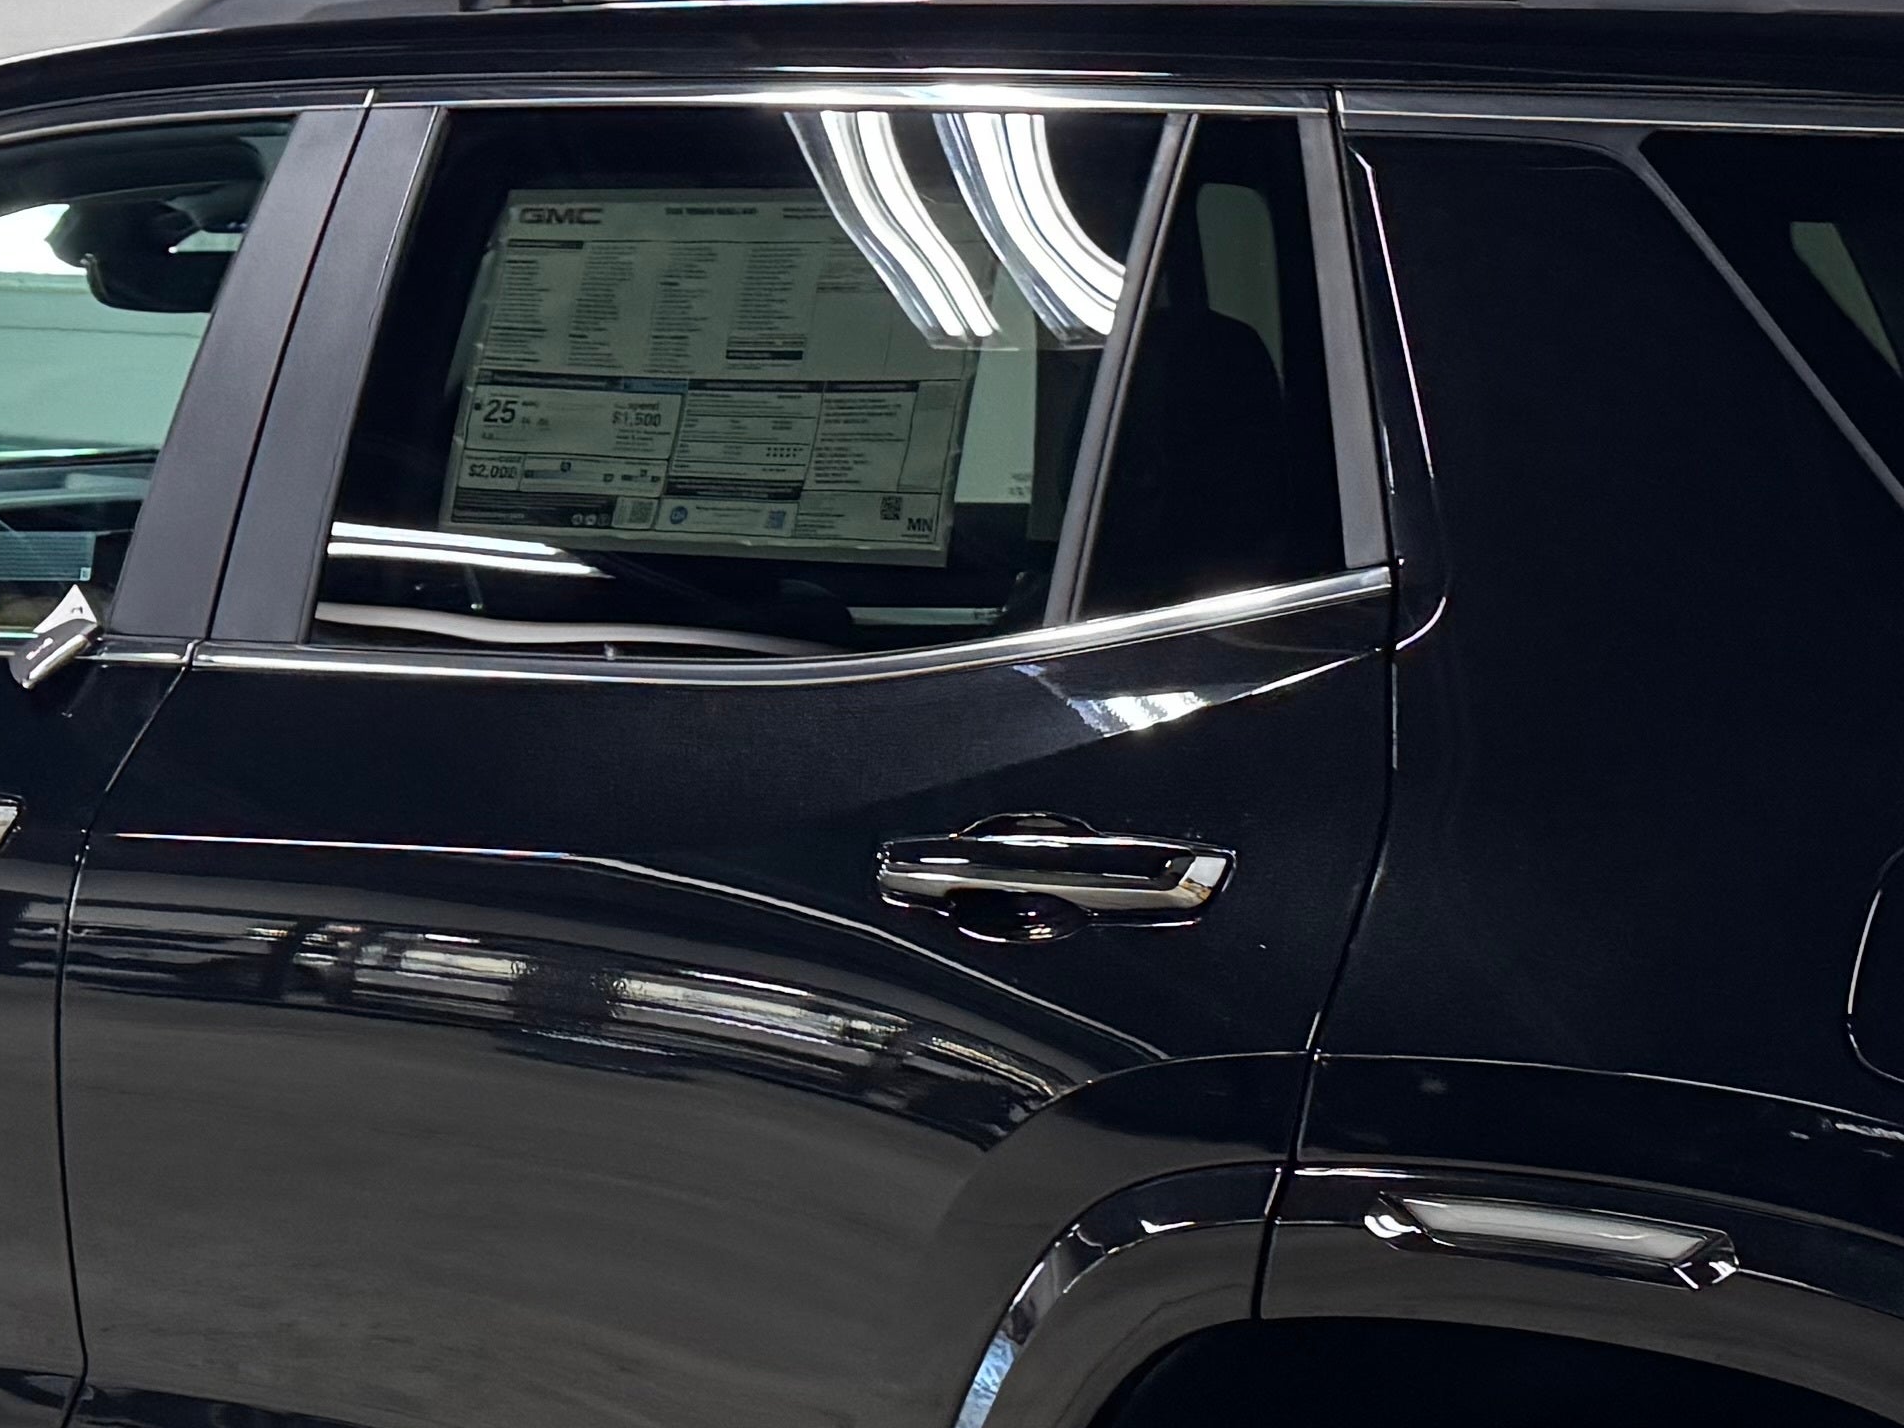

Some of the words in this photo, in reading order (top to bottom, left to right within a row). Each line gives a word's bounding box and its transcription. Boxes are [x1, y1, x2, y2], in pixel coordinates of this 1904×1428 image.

[519, 207, 604, 225] GMC
[483, 398, 518, 424] 25
[906, 517, 934, 533] MN
